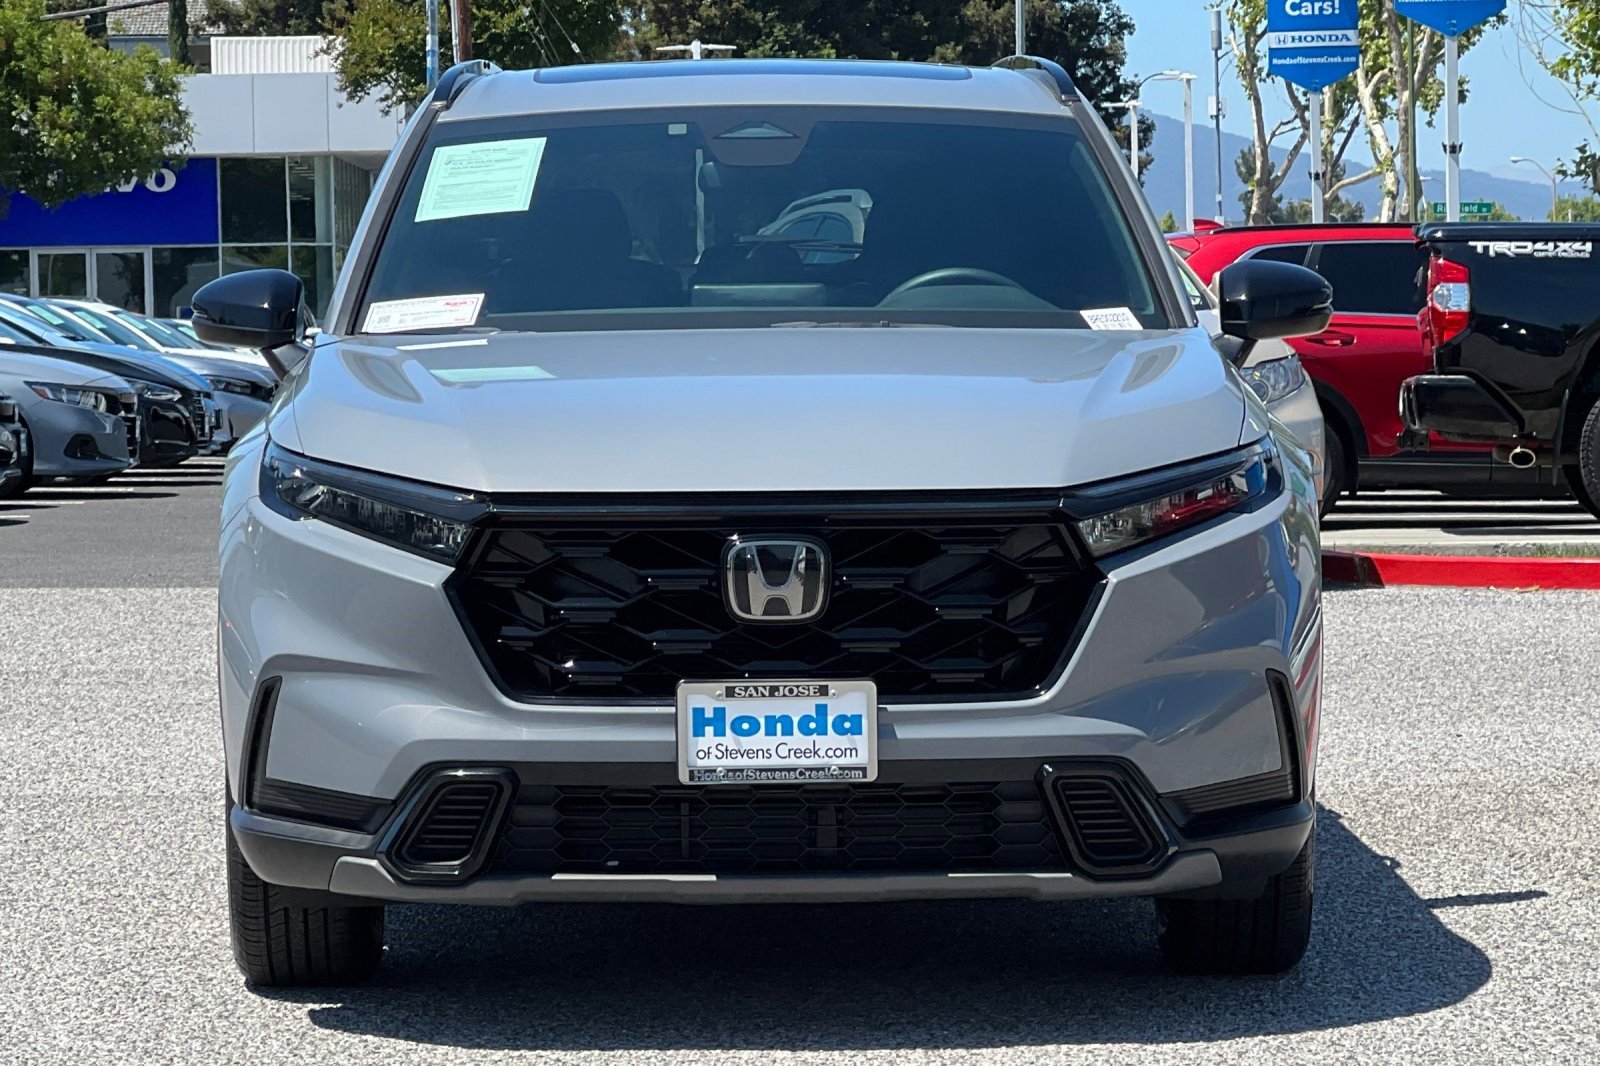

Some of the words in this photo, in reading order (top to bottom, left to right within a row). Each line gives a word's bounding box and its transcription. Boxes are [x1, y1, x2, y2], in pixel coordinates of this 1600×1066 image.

[1284, 0, 1340, 16] Cars!
[1290, 33, 1352, 44] HONDA
[1272, 55, 1357, 65] HondaofStevensCreek.com
[733, 686, 770, 698] SAN
[774, 684, 820, 697] JOSE
[691, 703, 863, 738] Honda
[695, 745, 713, 760] of
[714, 743, 773, 760] Stevens
[775, 740, 859, 759] Creek.com
